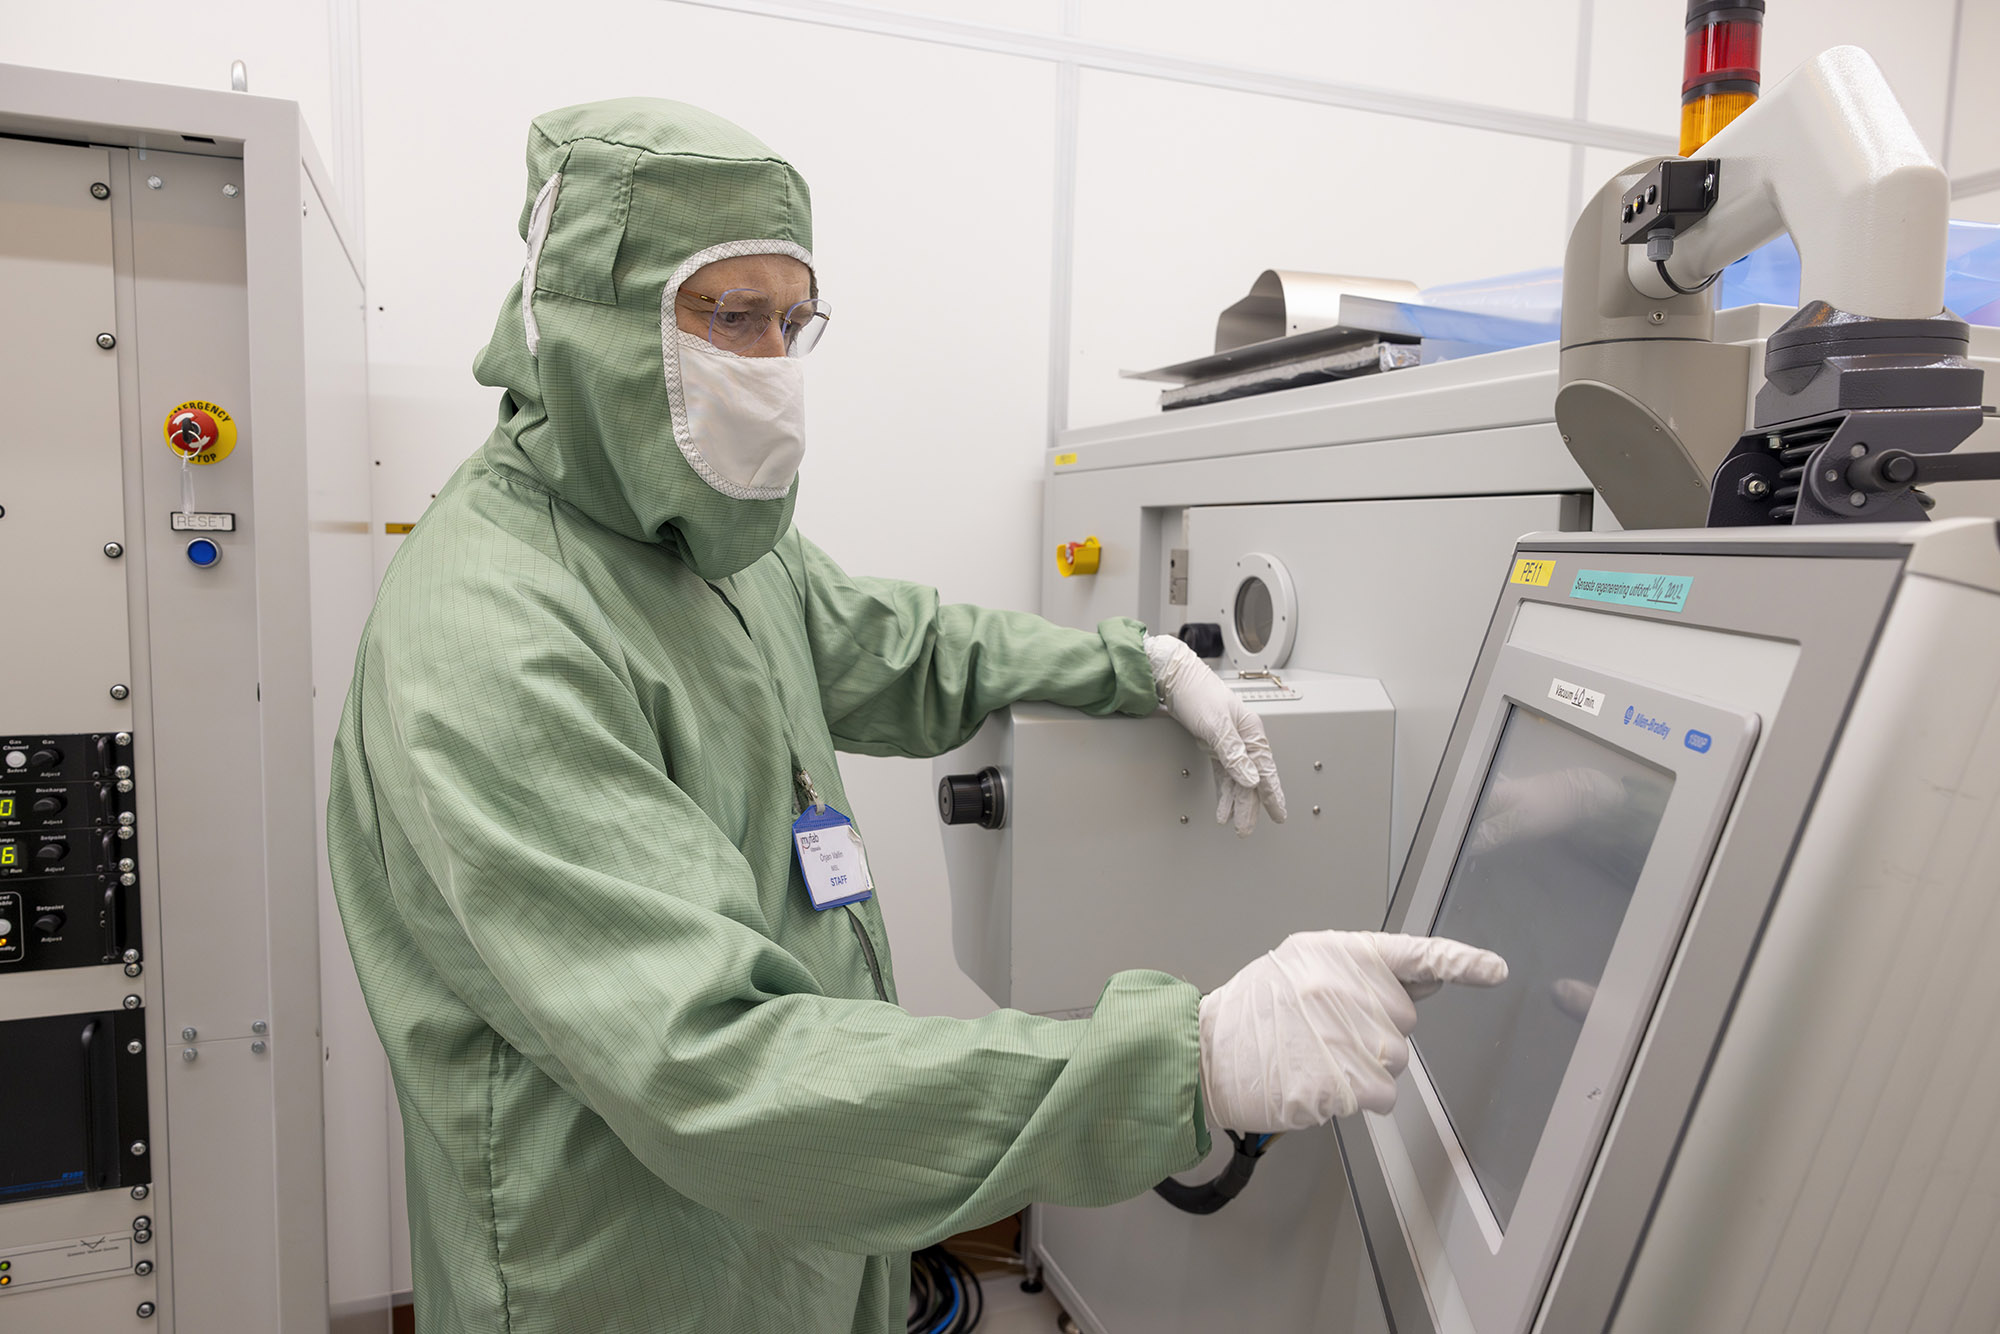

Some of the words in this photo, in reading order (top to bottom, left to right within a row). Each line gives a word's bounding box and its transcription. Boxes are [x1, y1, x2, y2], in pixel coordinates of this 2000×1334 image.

[176, 515, 227, 527] RESET
[1520, 562, 1543, 583] PE11
[1575, 577, 1595, 592] Senaste
[1594, 582, 1630, 599] regenerering
[1555, 684, 1573, 701] Vacuum
[1572, 689, 1585, 706] 40
[1633, 713, 1671, 740] Allen-Bradley
[1, 846, 15, 864] 6
[830, 875, 847, 887] STAFF
